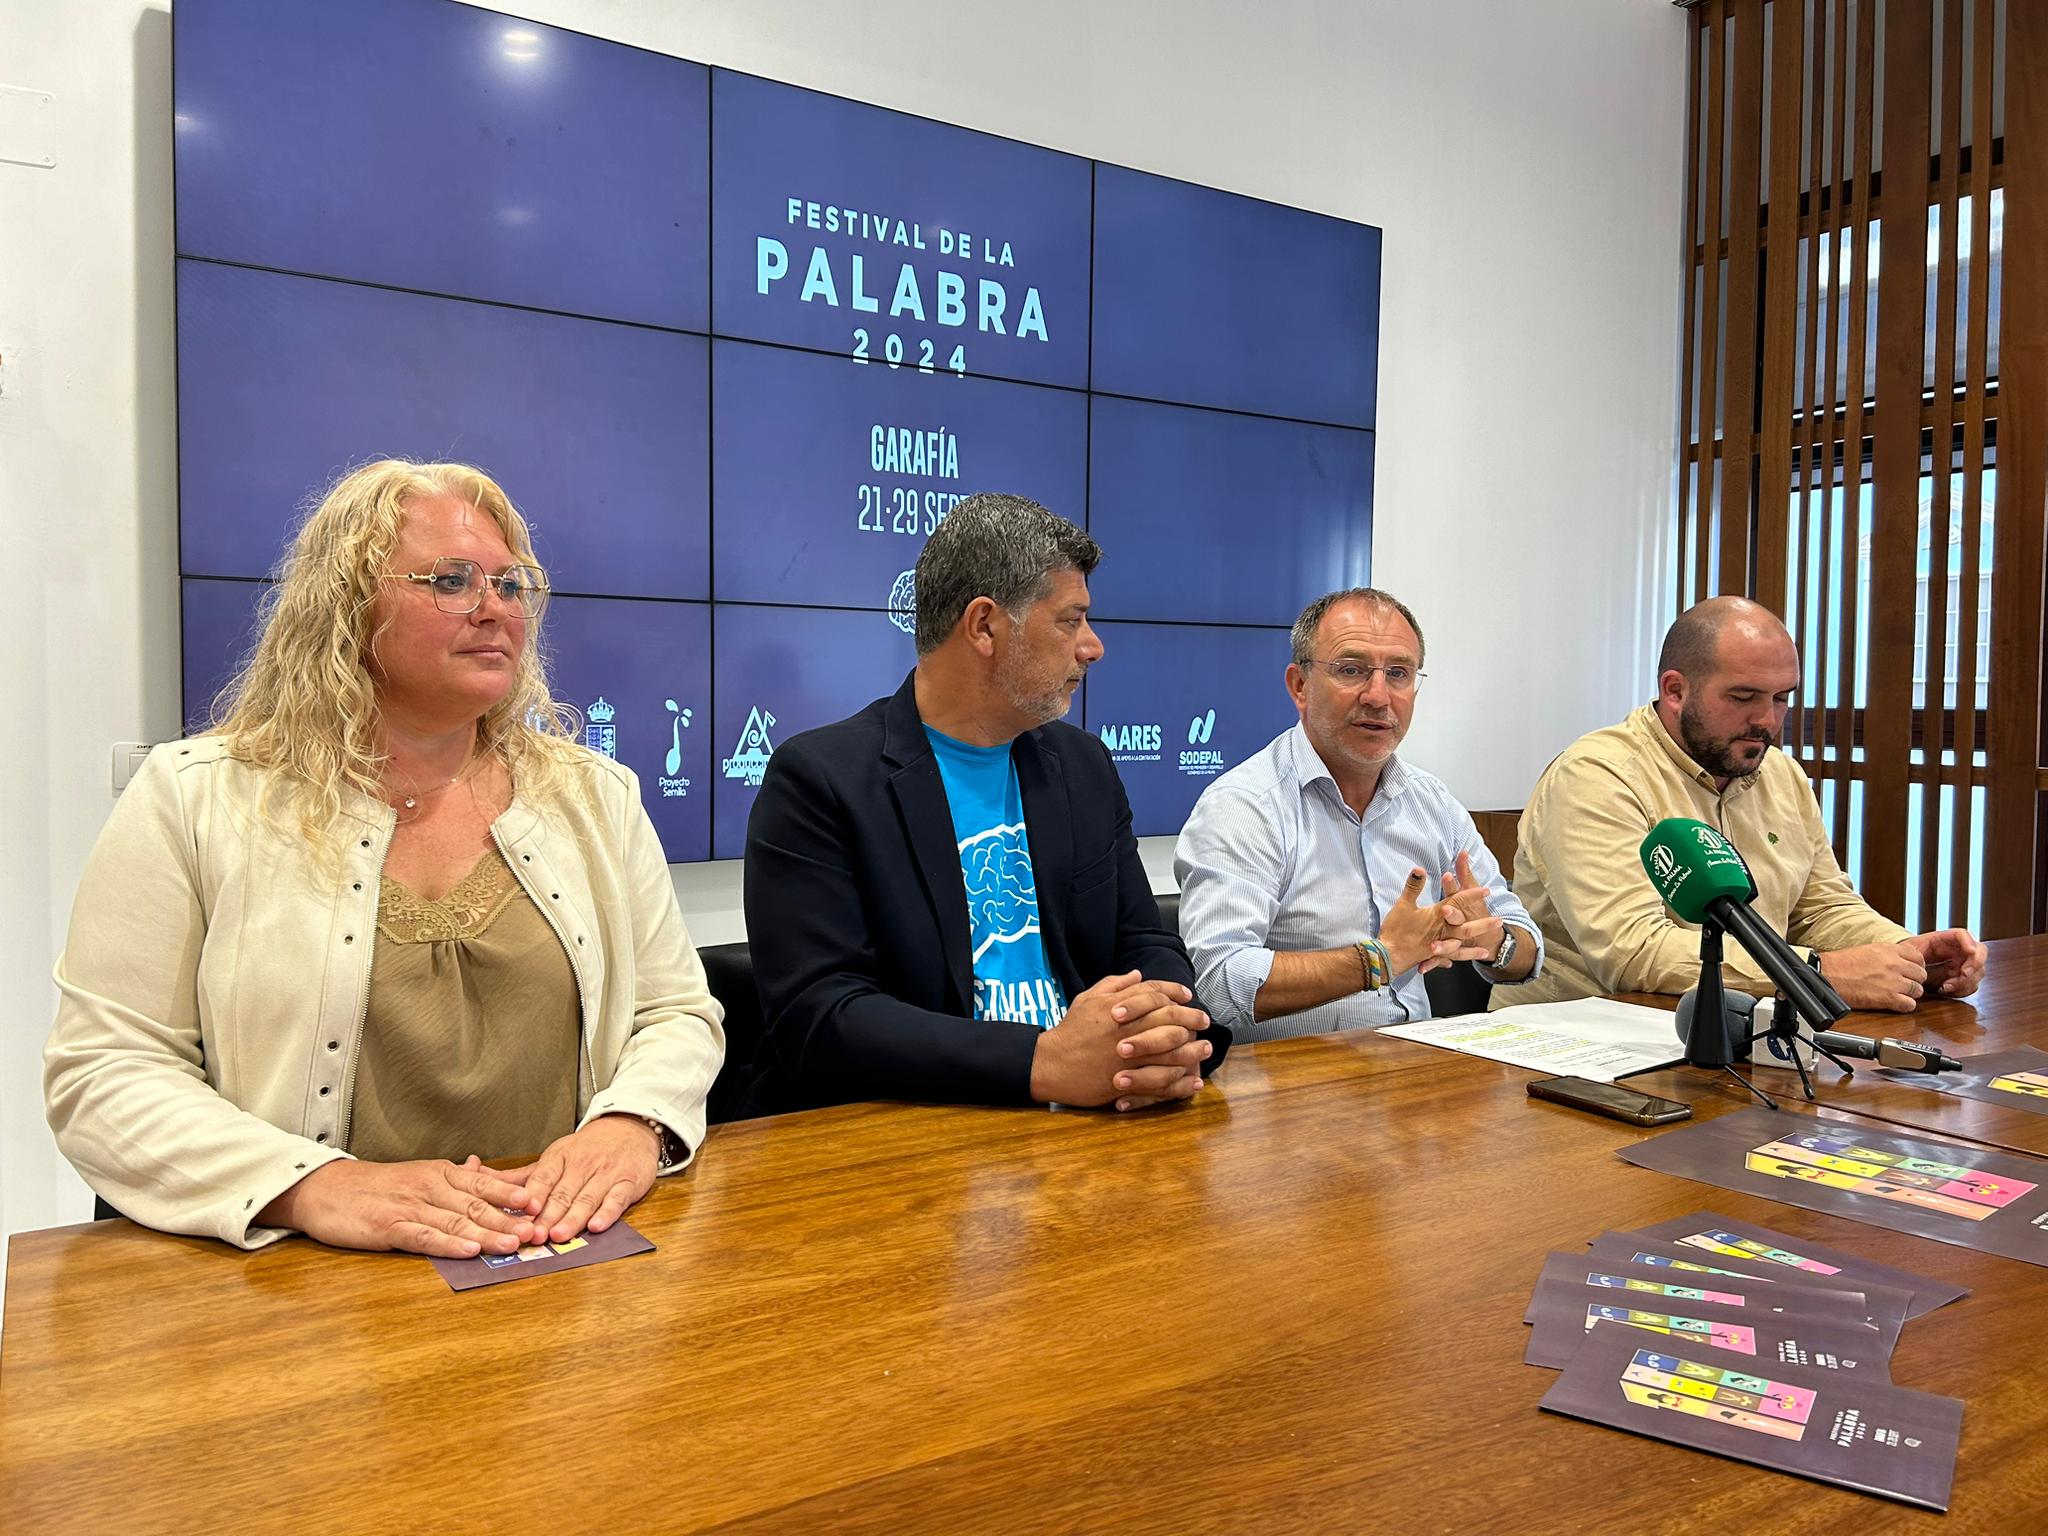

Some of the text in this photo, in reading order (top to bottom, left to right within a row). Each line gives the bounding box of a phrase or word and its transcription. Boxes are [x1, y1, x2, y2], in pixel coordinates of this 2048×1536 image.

[787, 197, 1015, 267] FESTIVAL DE LA
[756, 236, 1049, 342] PALABRA
[852, 328, 967, 379] 2024
[870, 425, 960, 479] GARAFÍA
[924, 490, 970, 537] SE
[1179, 750, 1224, 765] SODEPAL
[658, 777, 690, 788] Proyecto
[1661, 865, 1683, 888] LA PALMA
[1836, 1408, 1860, 1447] PALABRA
